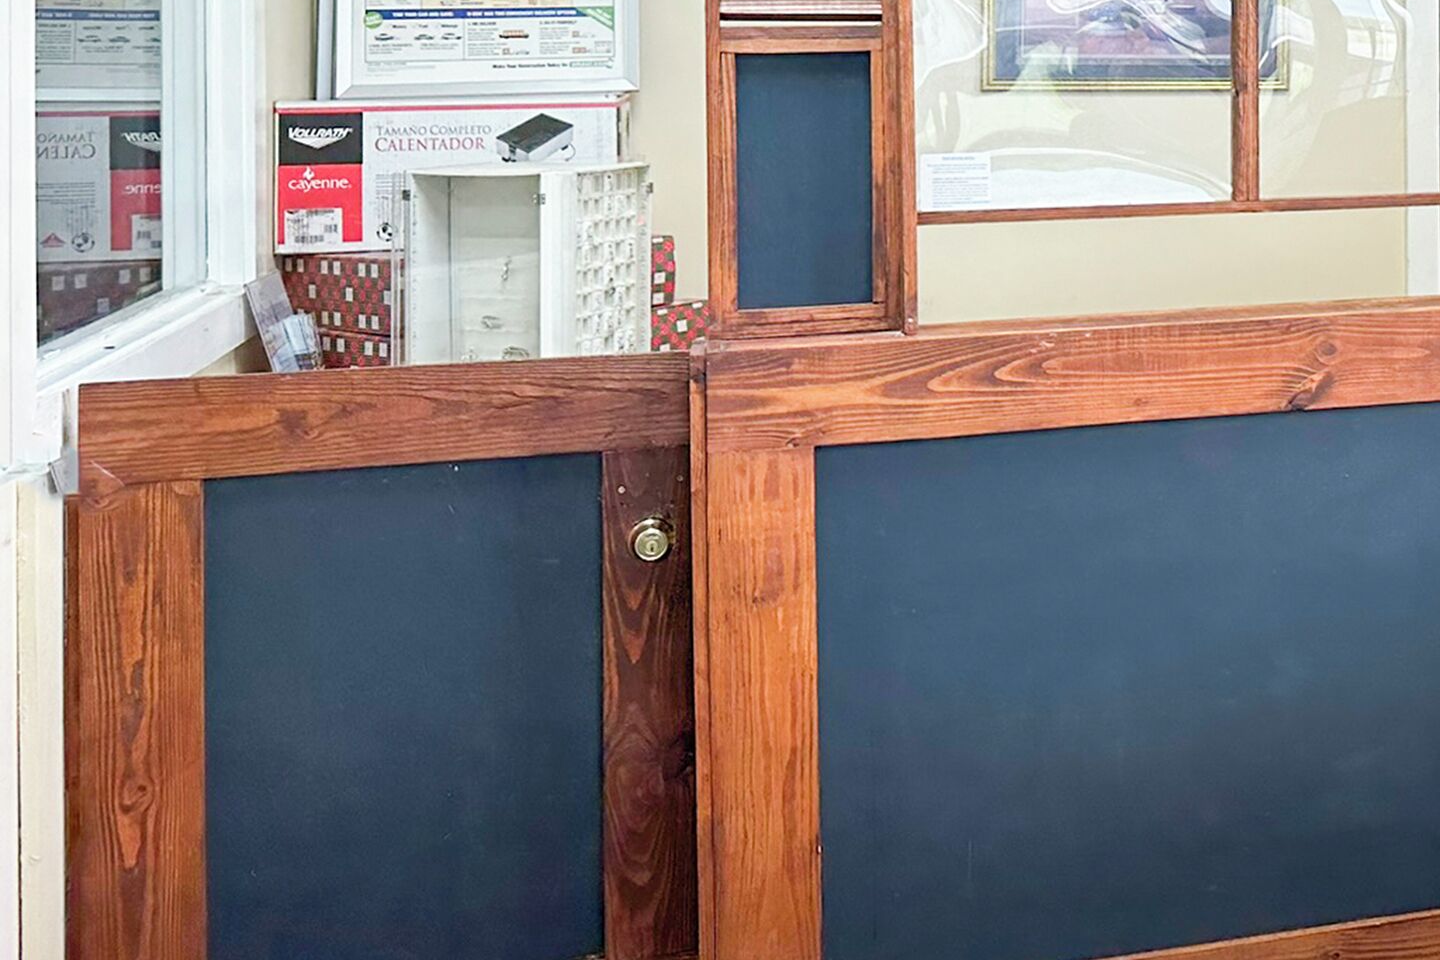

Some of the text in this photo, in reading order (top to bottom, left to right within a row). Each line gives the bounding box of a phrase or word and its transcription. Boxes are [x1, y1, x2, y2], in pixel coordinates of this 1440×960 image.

[288, 126, 348, 139] VOLLRATH
[430, 124, 492, 136] COMPLETO
[375, 137, 486, 152] CALENTADOR
[288, 178, 349, 193] cayenne
